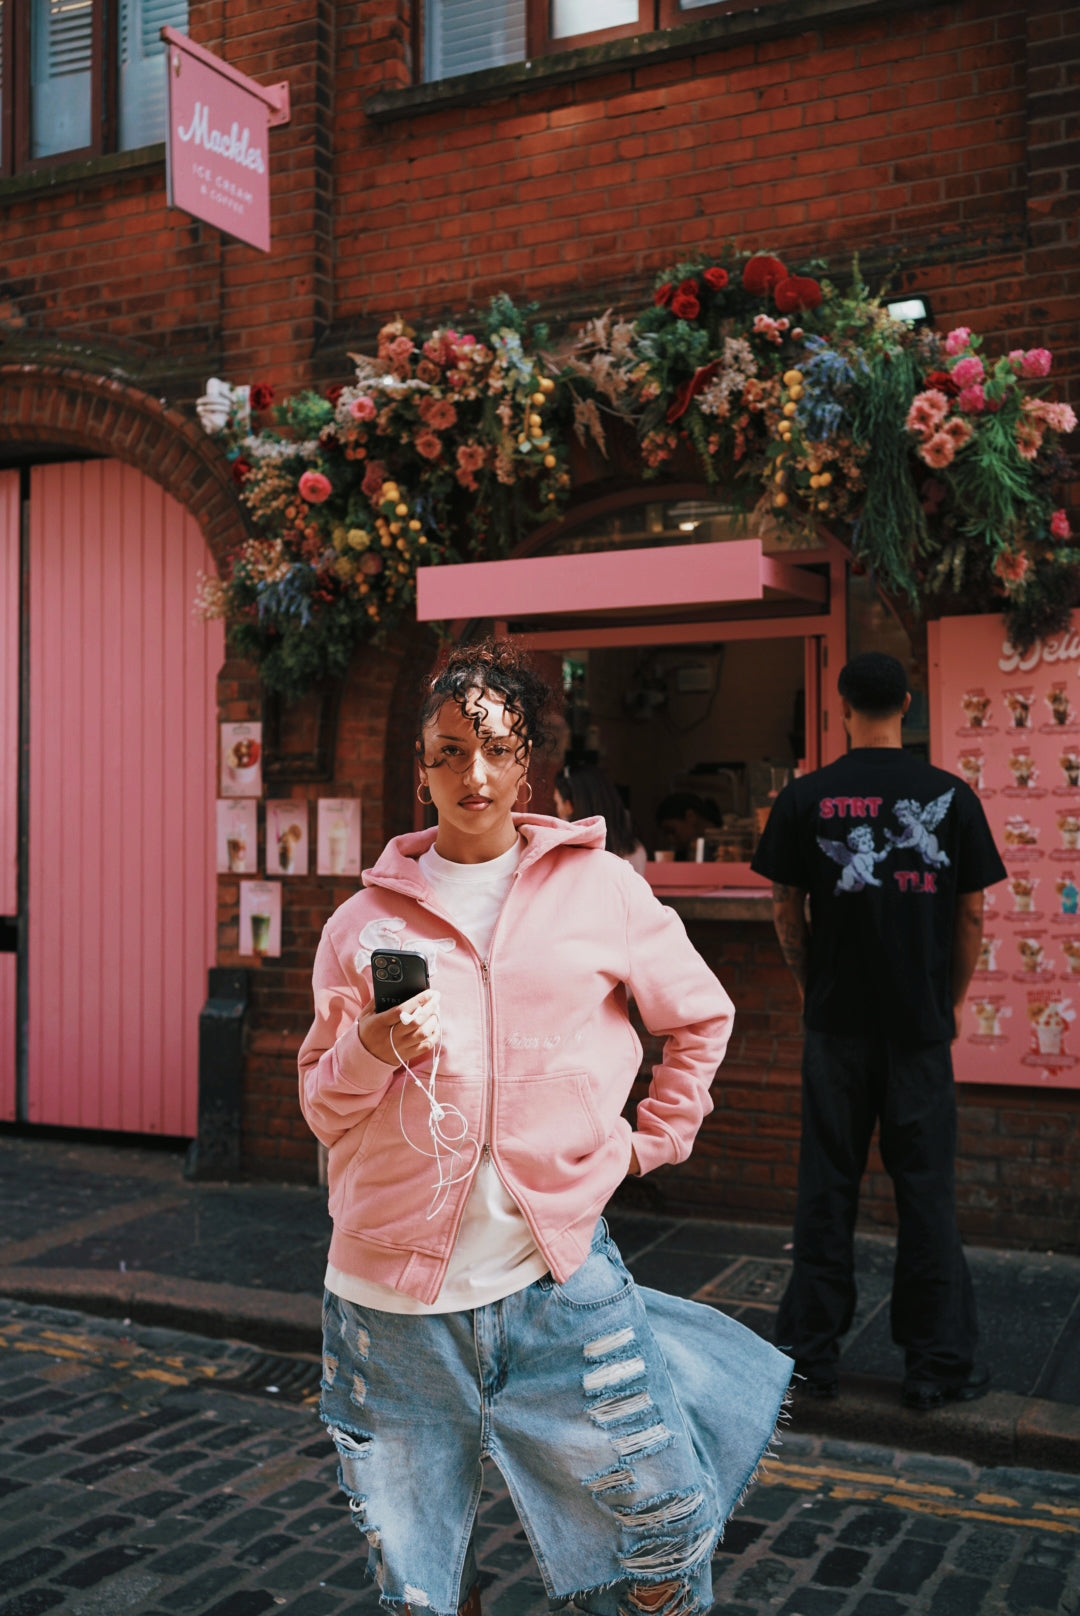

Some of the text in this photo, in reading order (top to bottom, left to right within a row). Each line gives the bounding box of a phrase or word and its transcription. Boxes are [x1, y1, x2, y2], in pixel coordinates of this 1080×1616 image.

[193, 164, 254, 205] ICE CREAM
[210, 189, 244, 215] COFFEE
[820, 796, 882, 818] STRT
